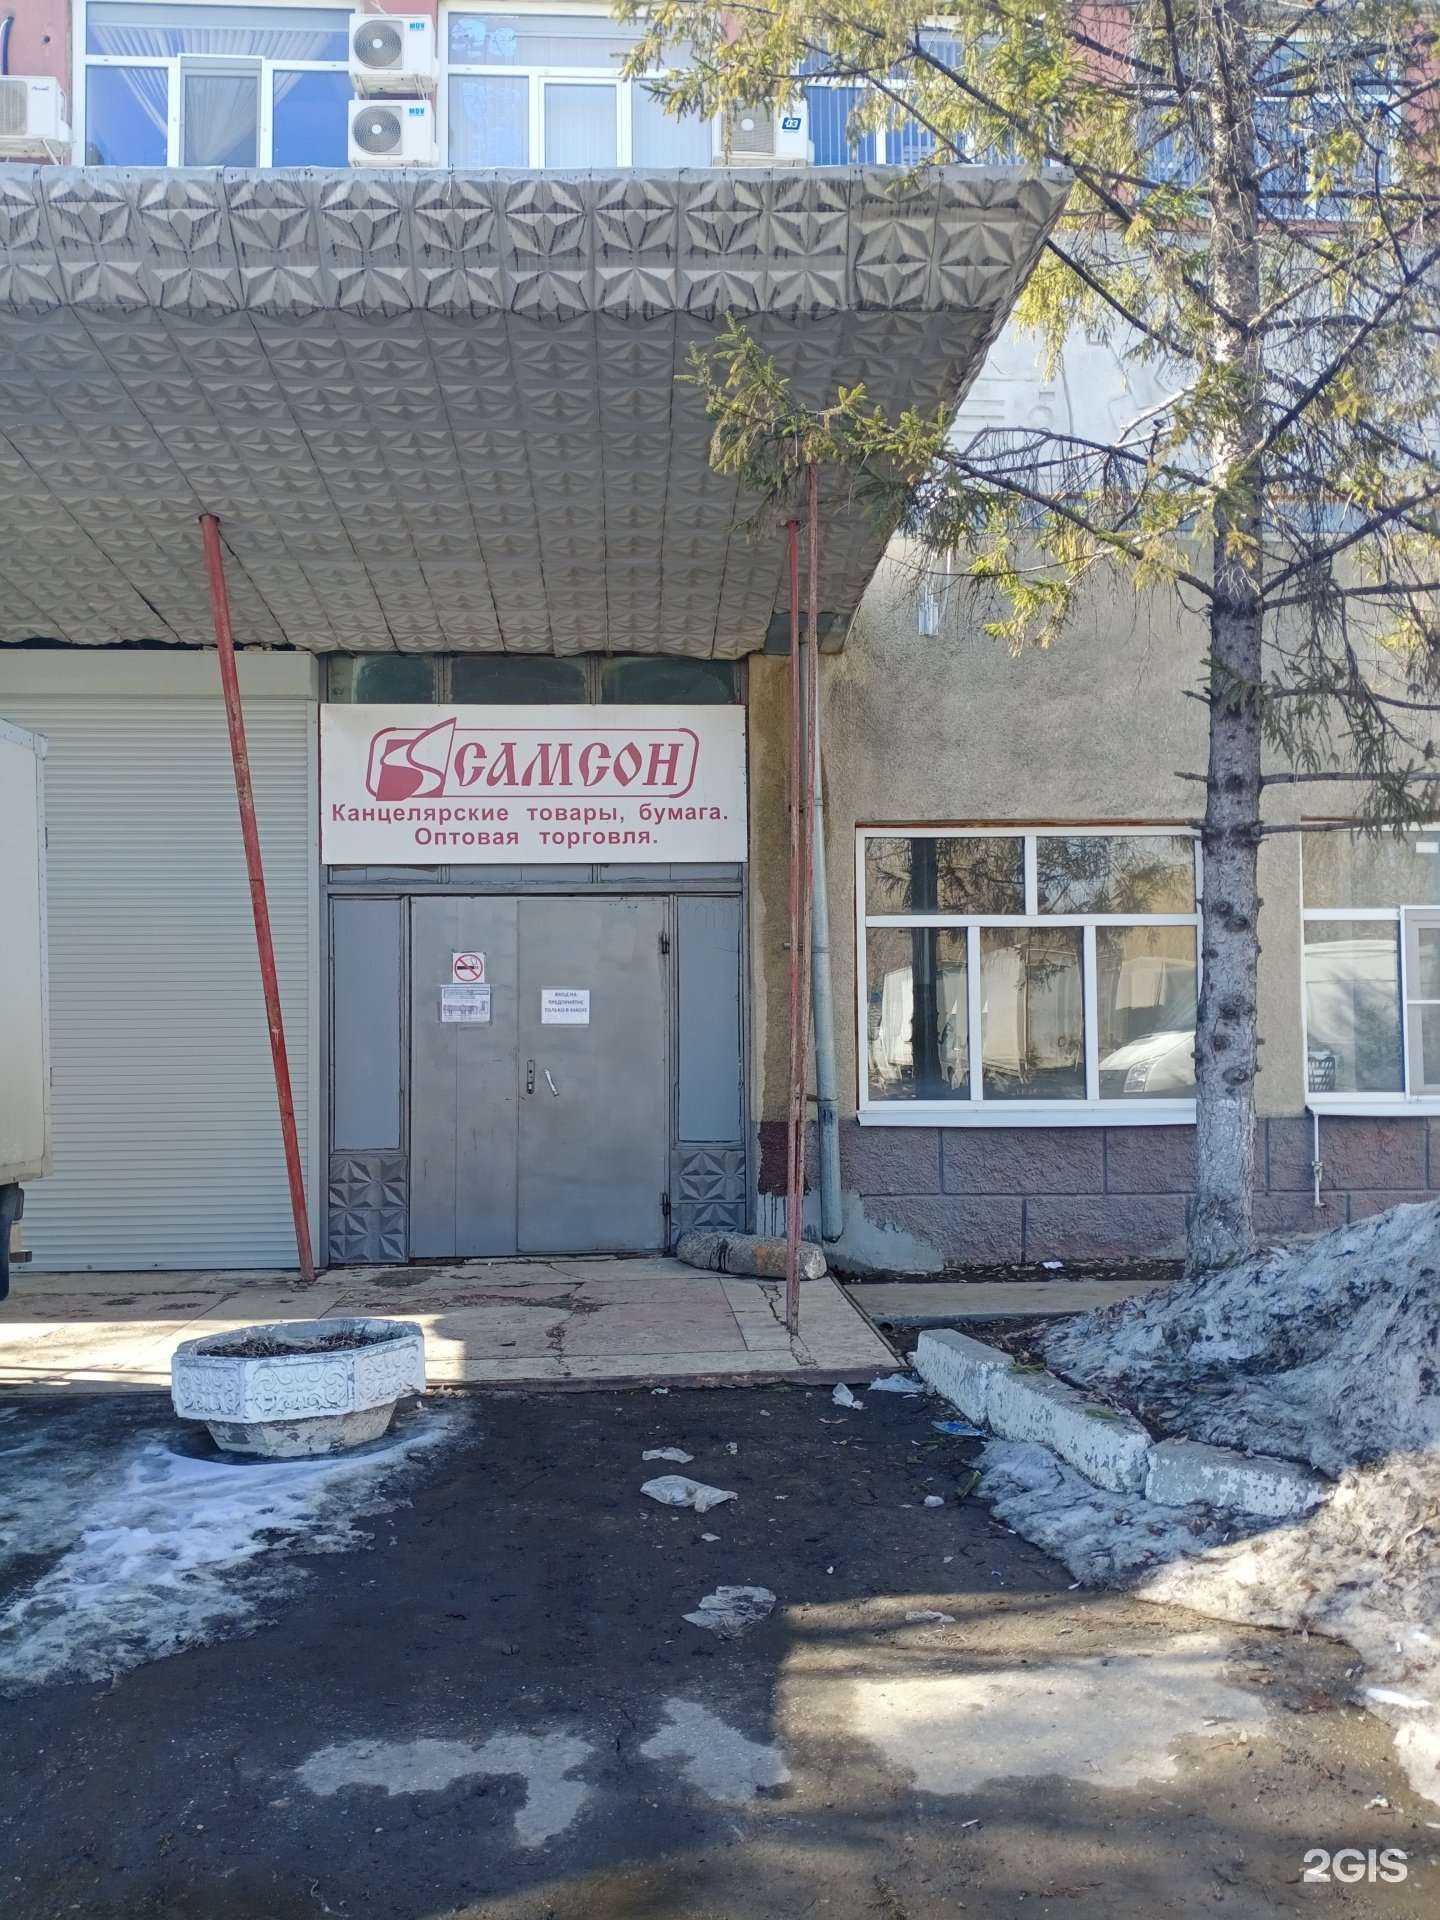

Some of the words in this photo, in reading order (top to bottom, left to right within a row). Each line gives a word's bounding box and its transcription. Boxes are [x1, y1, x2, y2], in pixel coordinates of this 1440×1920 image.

[454, 741, 684, 787] САМСОН
[332, 803, 509, 825] Канцелярские
[527, 805, 625, 825] товары,
[639, 803, 729, 825] бумага.
[415, 827, 520, 845] Оптовая
[539, 829, 658, 849] торговля.
